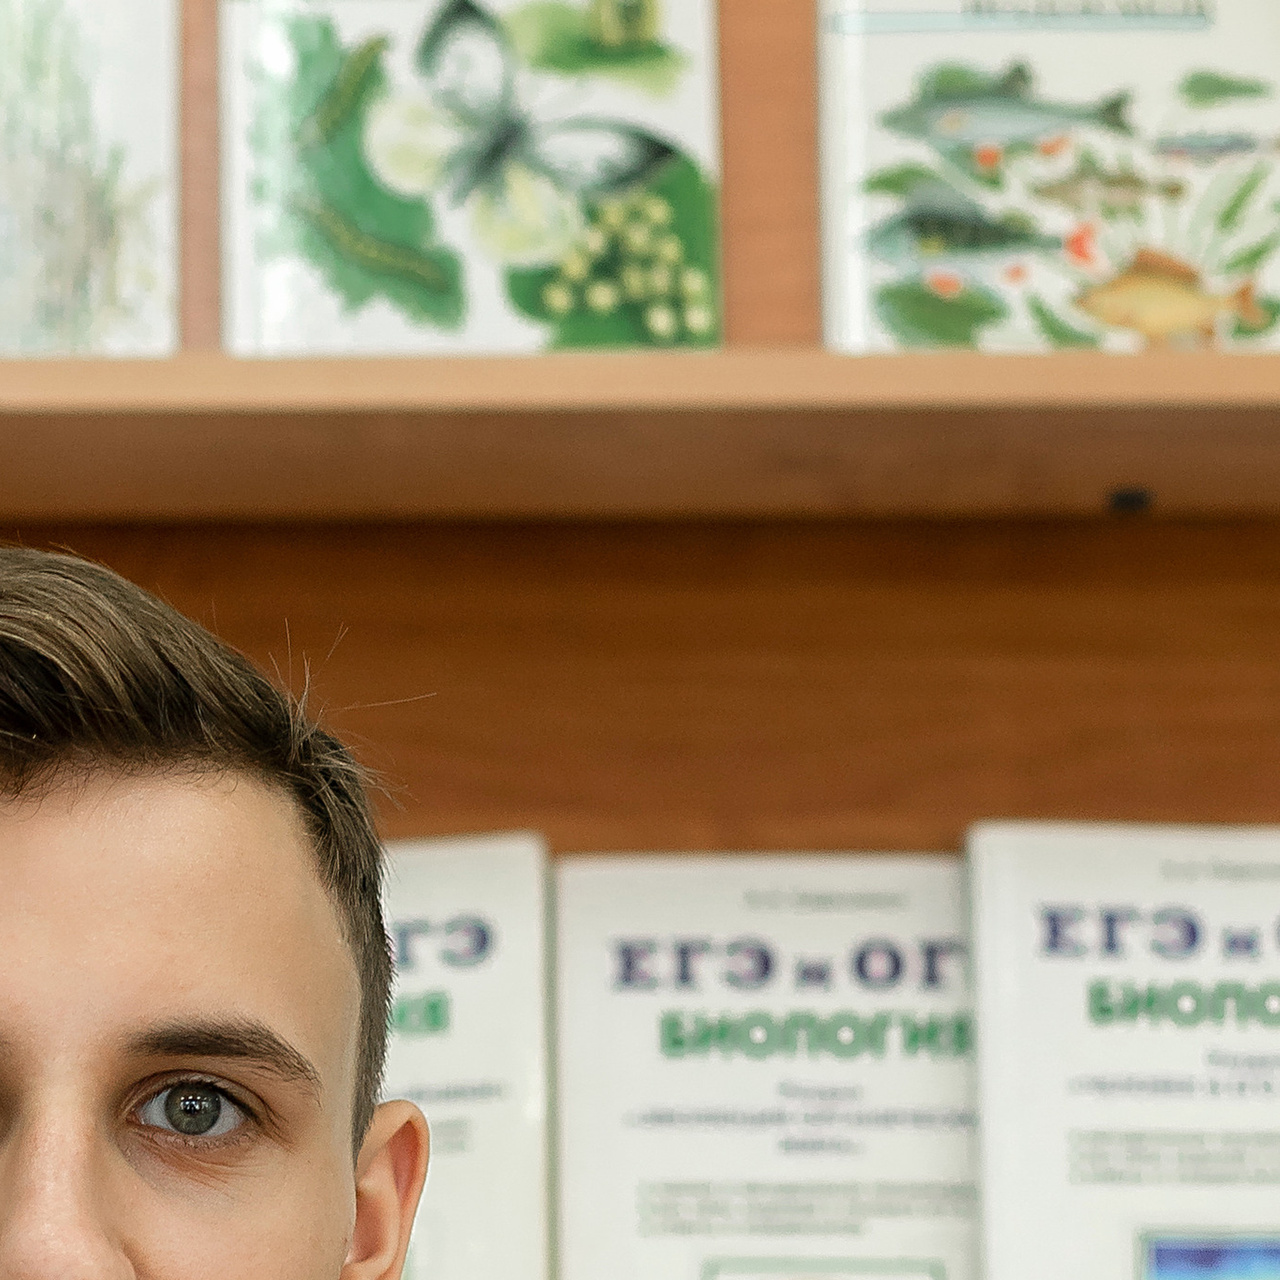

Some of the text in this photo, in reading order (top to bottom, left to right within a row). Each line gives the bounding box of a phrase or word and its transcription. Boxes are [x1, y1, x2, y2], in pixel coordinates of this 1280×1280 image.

[390, 914, 496, 970] ГЭ
[1036, 904, 1204, 957] ЕГЭ
[614, 938, 775, 988] ЕГЭ
[853, 937, 968, 990] ОГ
[1087, 980, 1280, 1026] БИОЛО
